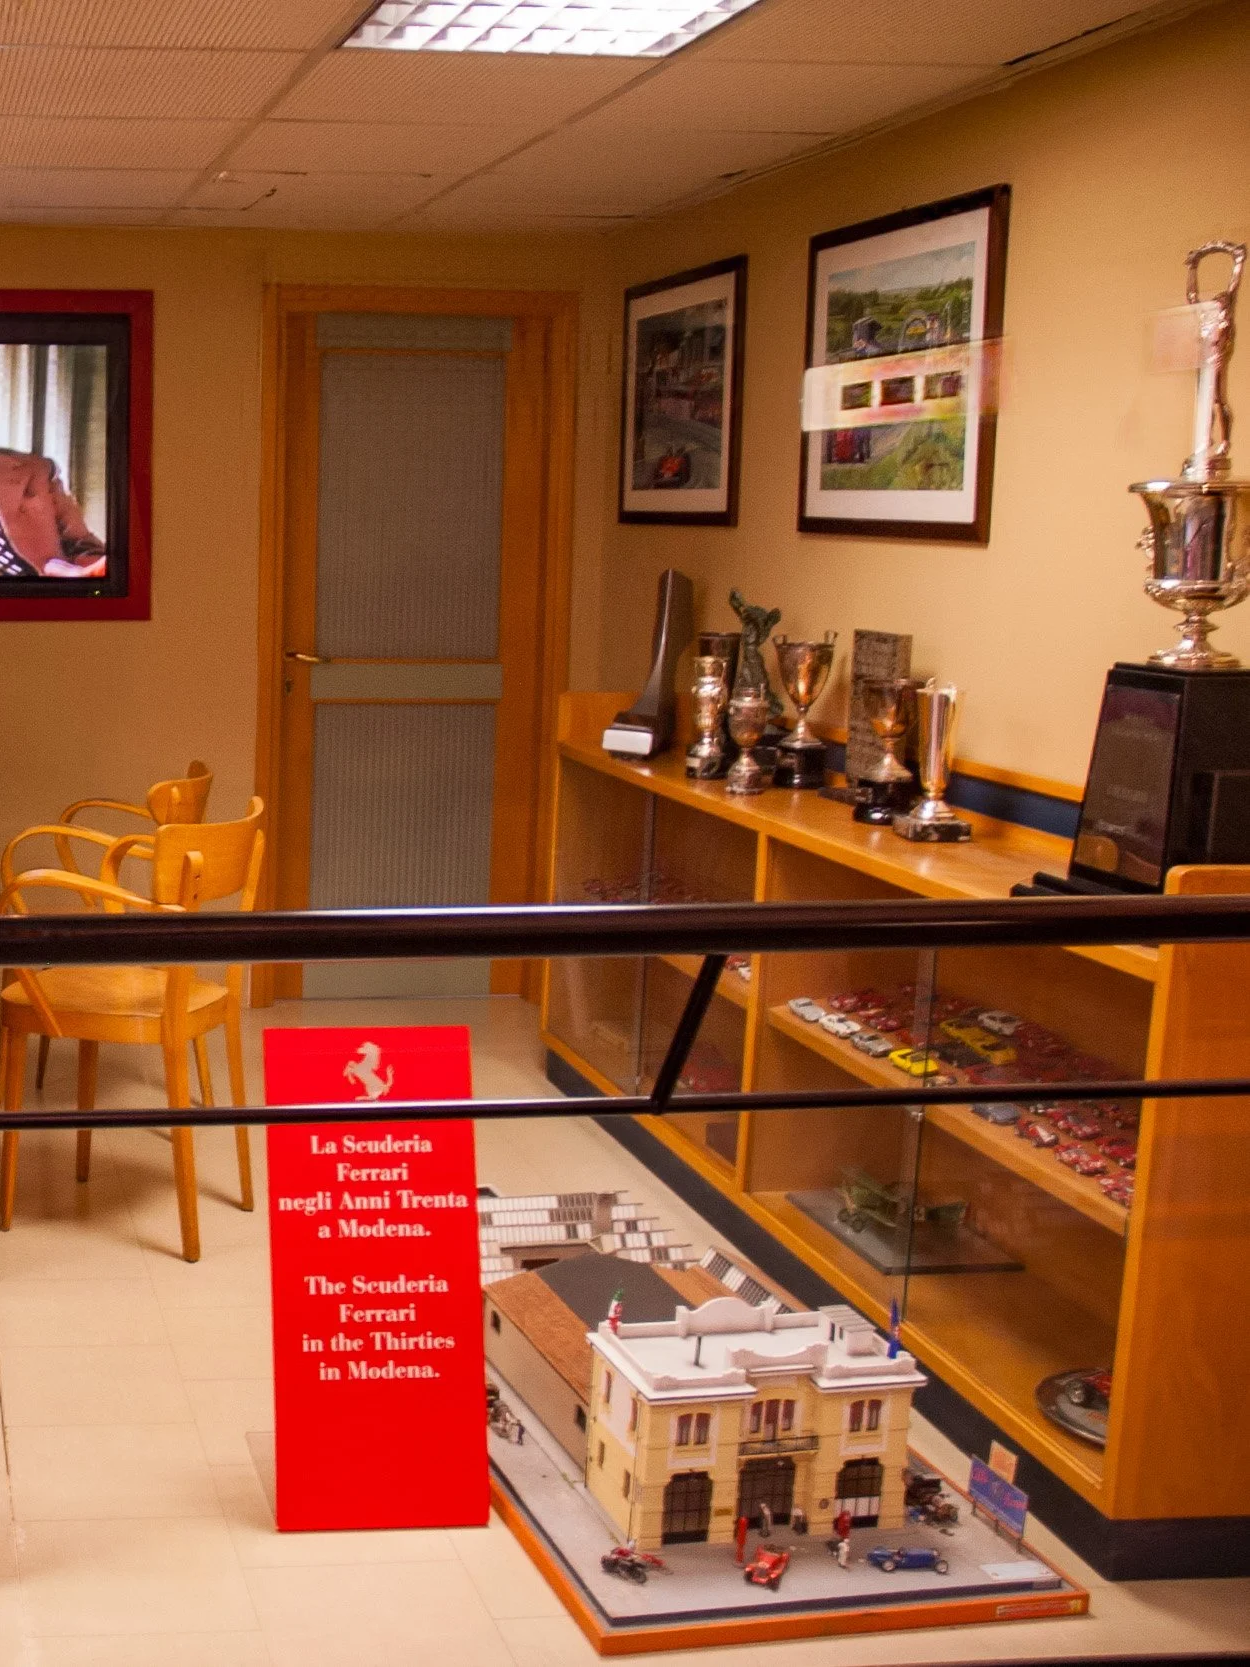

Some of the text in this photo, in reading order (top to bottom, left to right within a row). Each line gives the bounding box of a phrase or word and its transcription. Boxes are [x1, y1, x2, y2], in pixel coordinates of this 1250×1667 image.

[310, 1134, 433, 1155] La Scuderia
[336, 1163, 409, 1182] Ferrari
[278, 1189, 469, 1216] negli Anni Trenta
[317, 1218, 432, 1239] a Modena.
[304, 1274, 449, 1295] The Scuderia
[339, 1303, 416, 1323] Ferrari
[302, 1331, 456, 1352] in the Thirties
[319, 1360, 440, 1381] in Modena.
